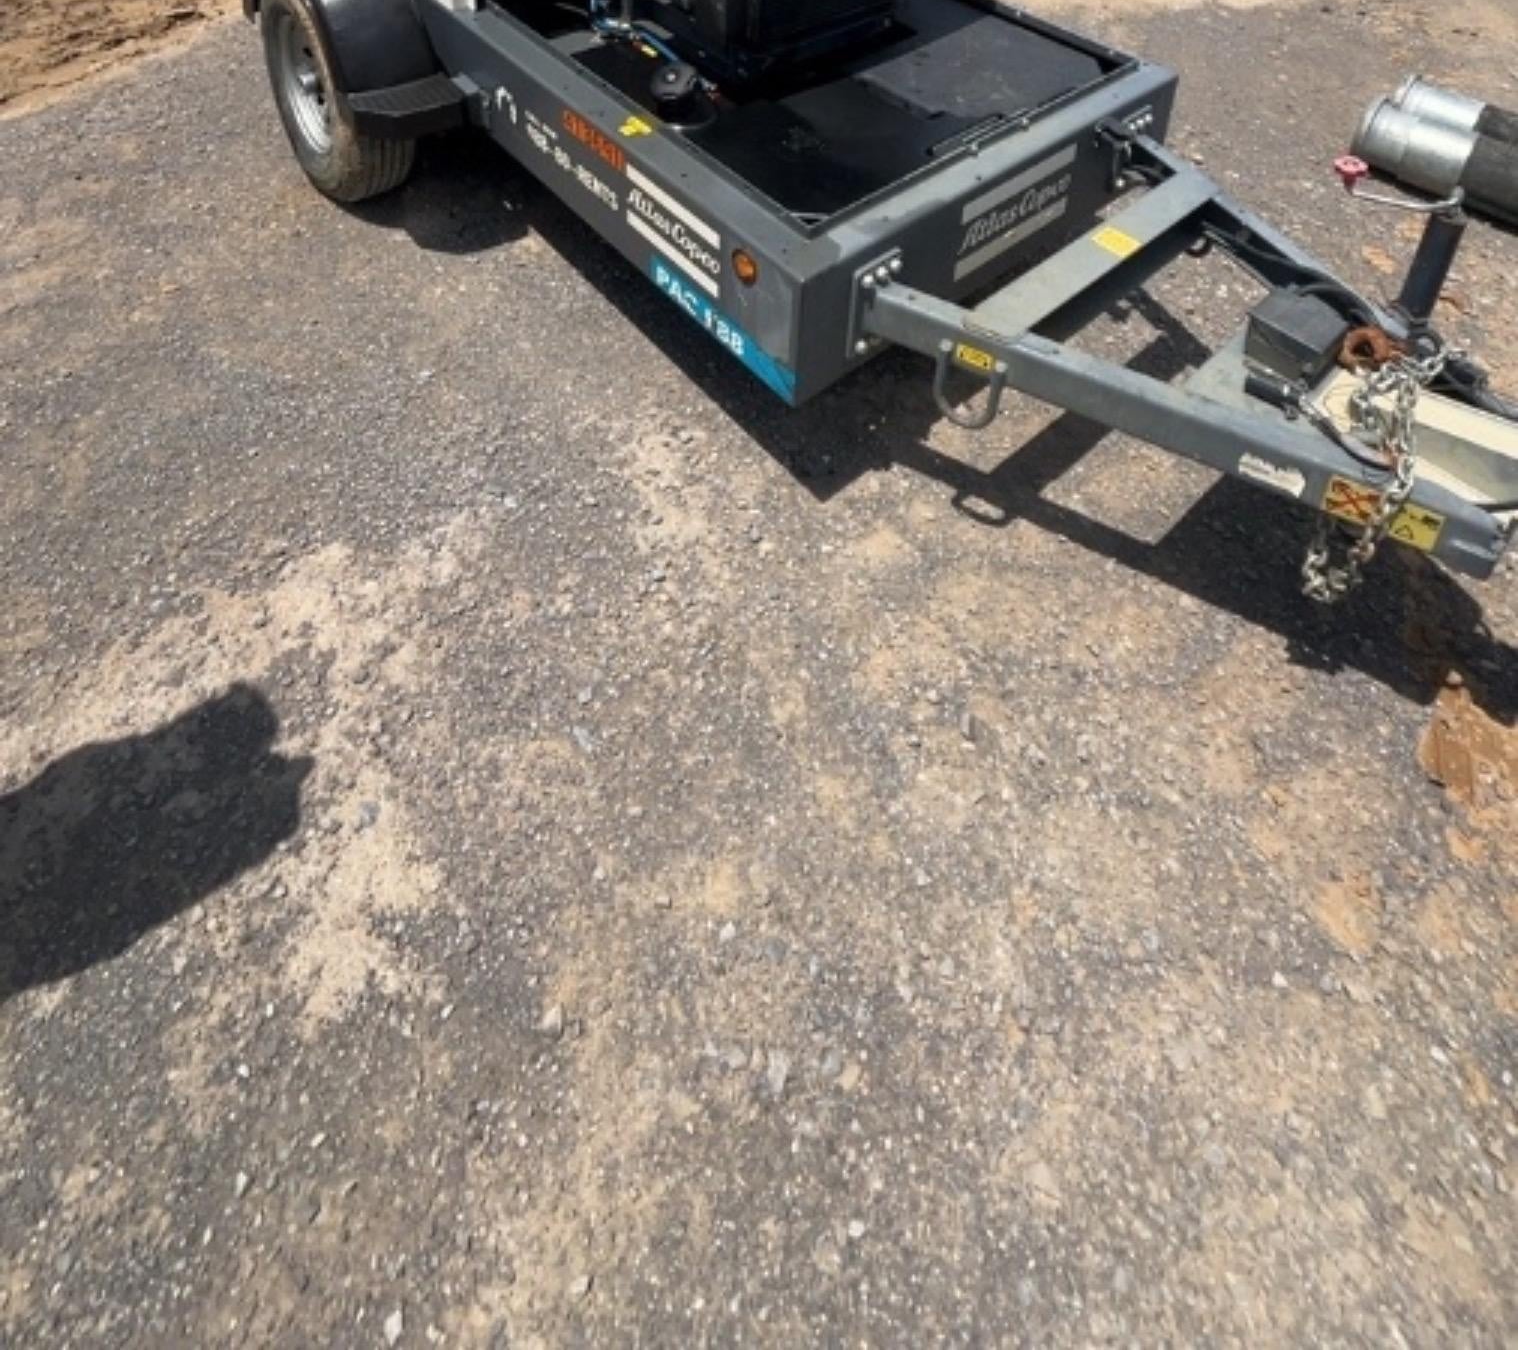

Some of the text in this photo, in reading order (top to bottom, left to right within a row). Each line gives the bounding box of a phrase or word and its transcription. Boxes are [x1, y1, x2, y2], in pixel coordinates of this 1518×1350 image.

[626, 187, 721, 275] Atlas Copco
[957, 172, 1072, 256] Atlas Copco
[655, 264, 699, 317] PAC
